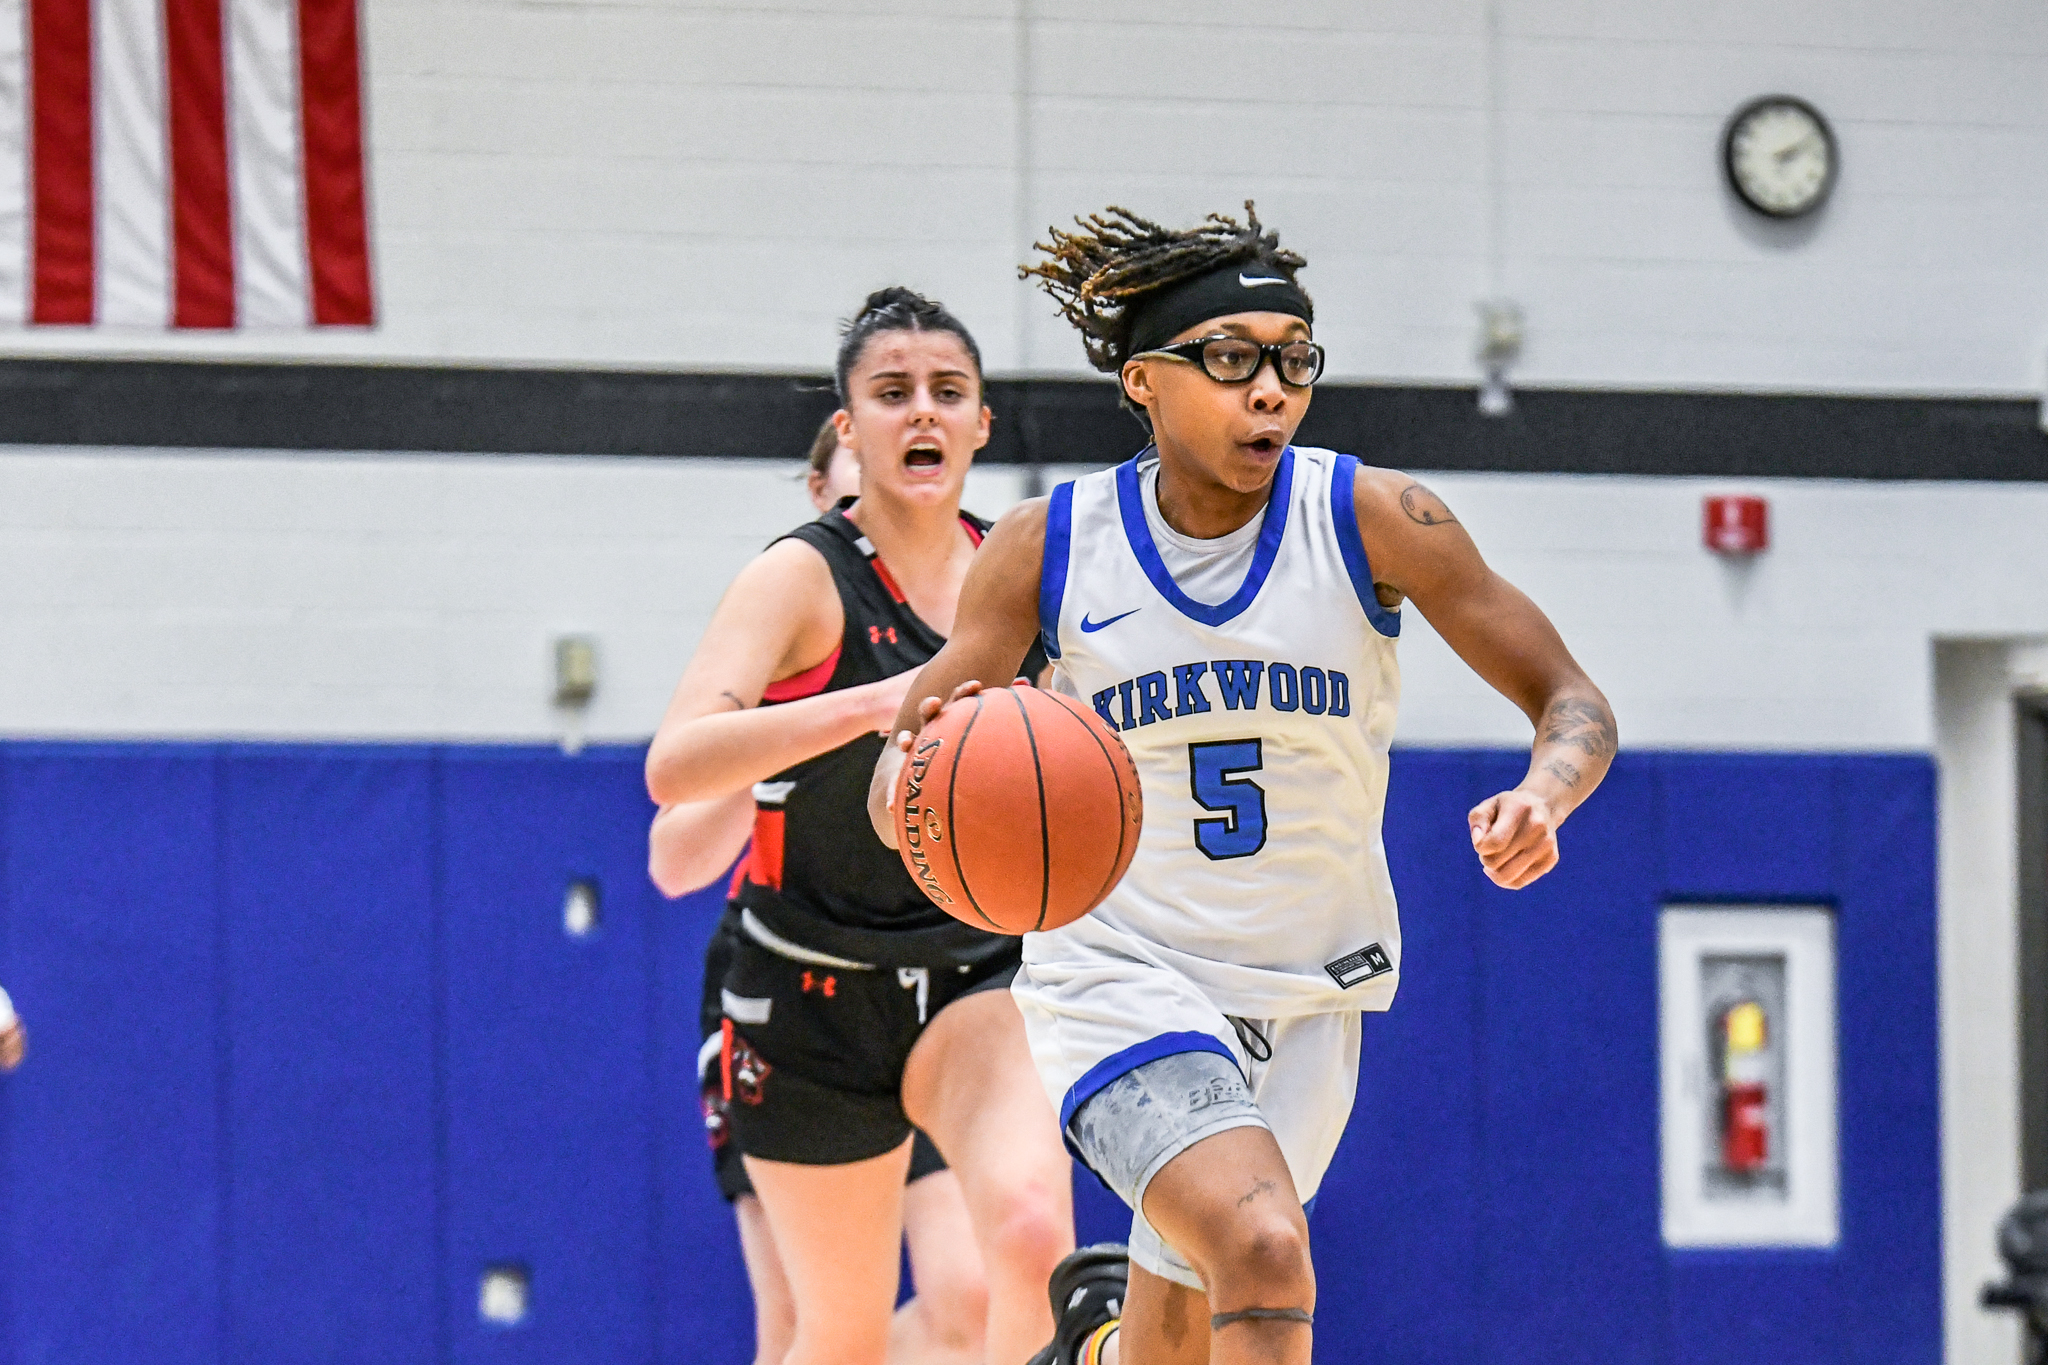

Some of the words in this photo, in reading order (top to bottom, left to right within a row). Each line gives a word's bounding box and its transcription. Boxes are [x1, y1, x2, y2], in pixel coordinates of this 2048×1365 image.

[1092, 660, 1350, 732] KIRKWOOD
[1188, 738, 1268, 861] 5
[1369, 952, 1385, 967] M
